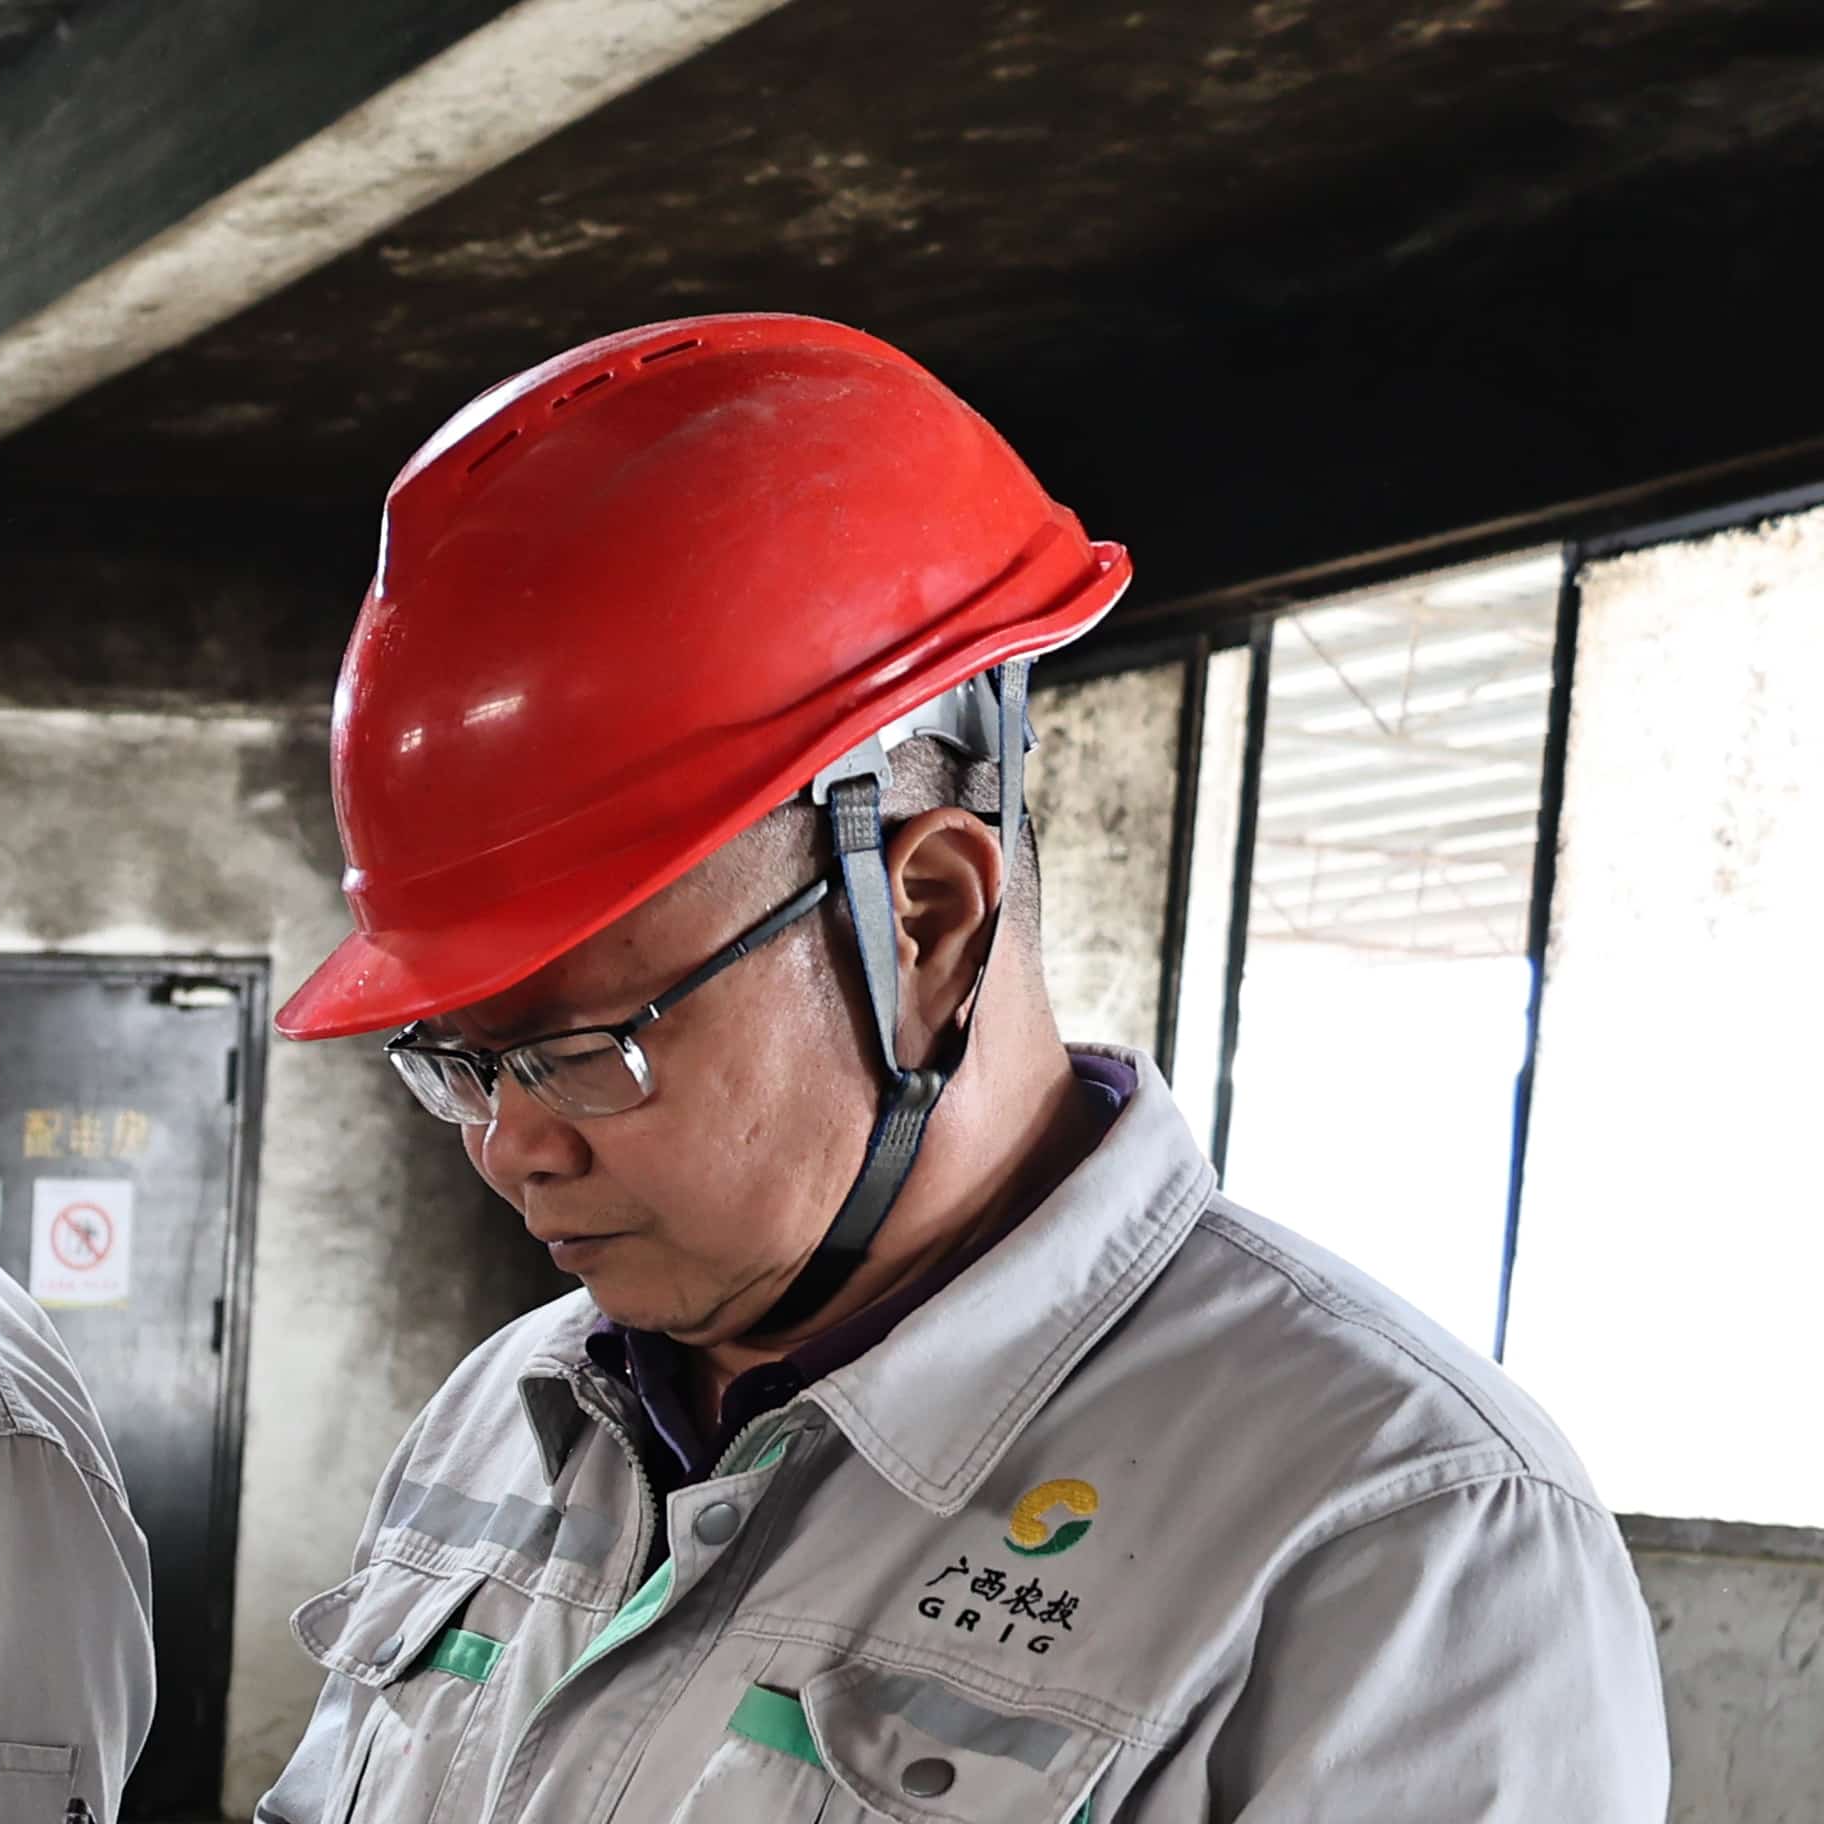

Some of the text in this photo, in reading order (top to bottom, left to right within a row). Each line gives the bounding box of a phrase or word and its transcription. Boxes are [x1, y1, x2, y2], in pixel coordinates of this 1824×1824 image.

[917, 1596, 1056, 1655] GRIG
[924, 1555, 1080, 1631] 广西农投
